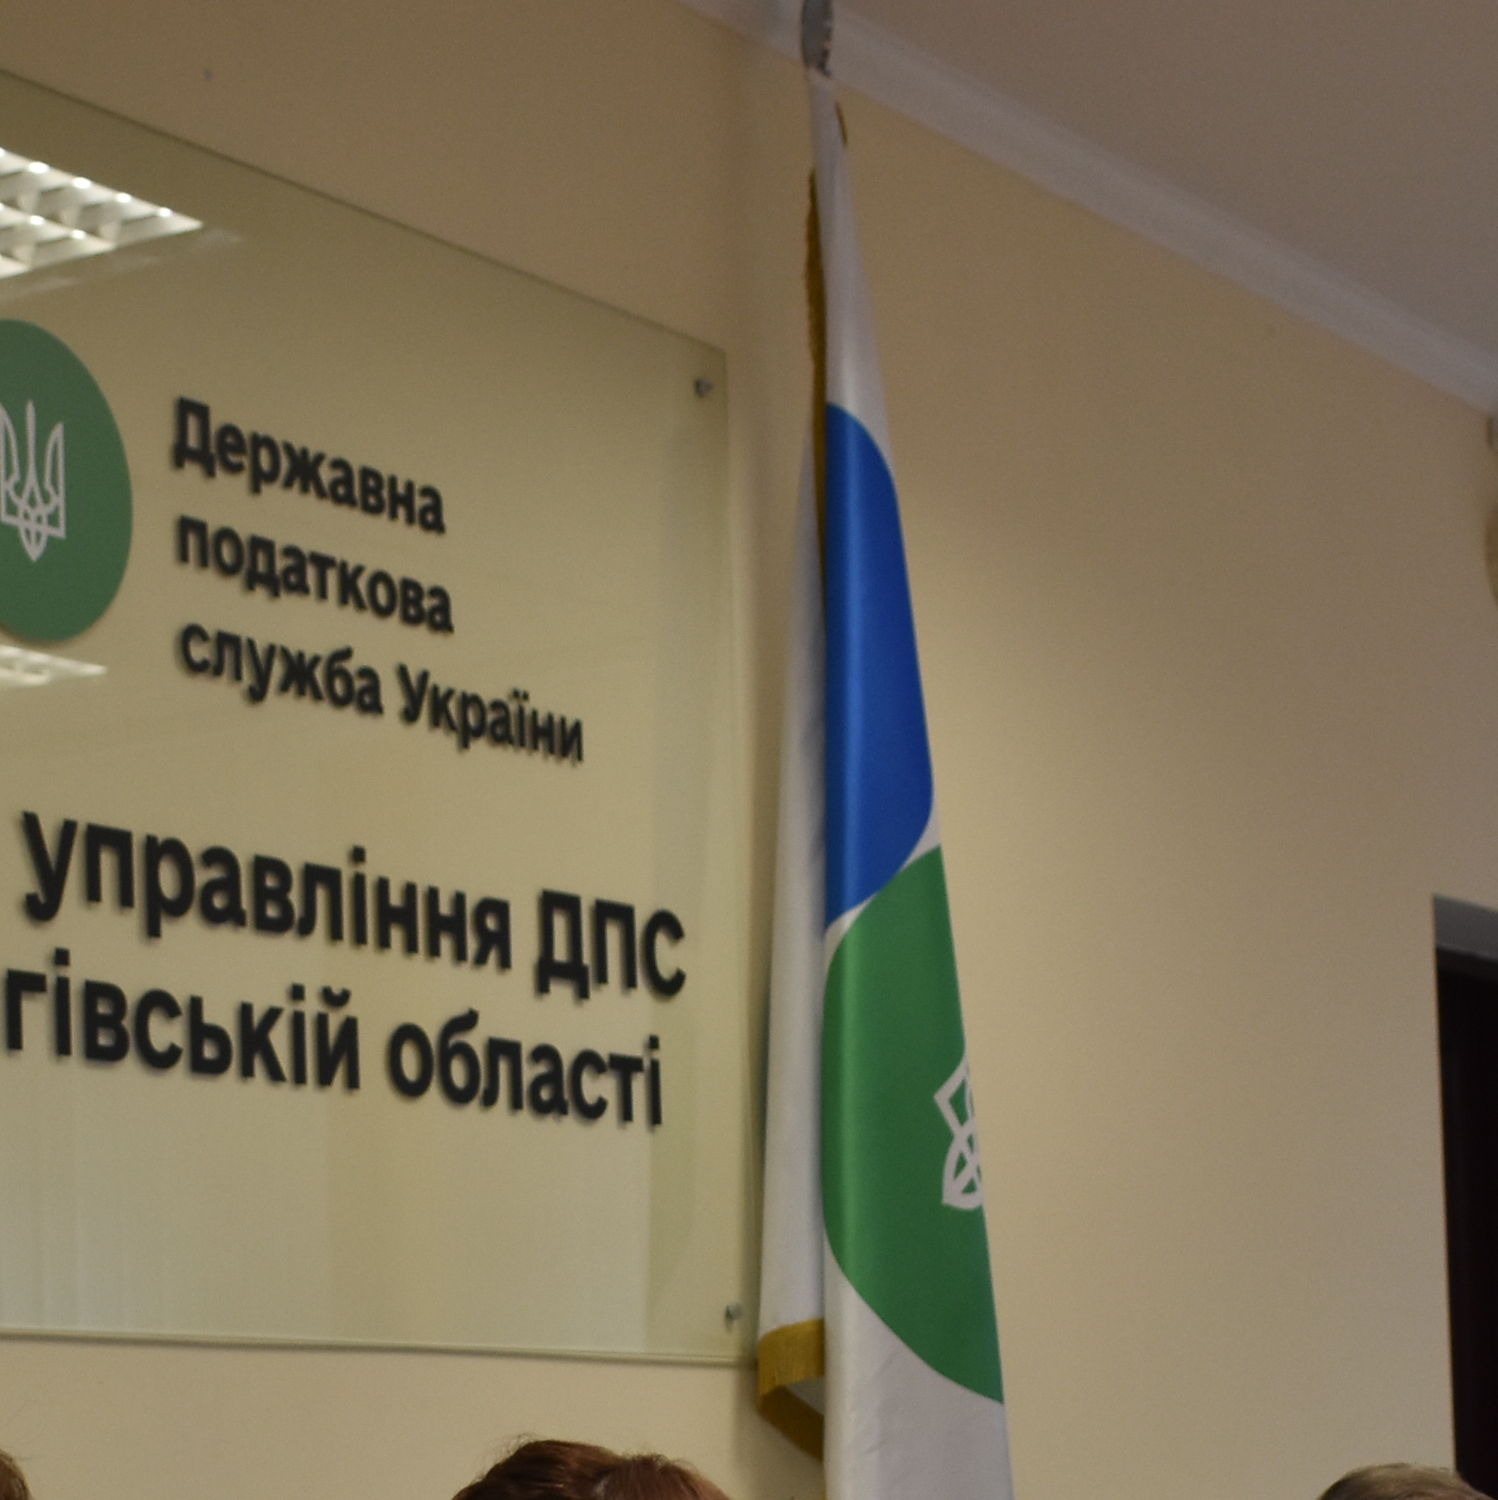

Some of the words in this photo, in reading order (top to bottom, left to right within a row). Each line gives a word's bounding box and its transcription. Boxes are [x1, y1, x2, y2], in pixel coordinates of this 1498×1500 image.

[172, 397, 445, 534] Державна
[177, 516, 453, 633] податкова
[180, 624, 383, 714] служба
[398, 665, 582, 761] України
[22, 812, 512, 970] управління
[536, 890, 685, 998] ДПС
[387, 1010, 662, 1126] області
